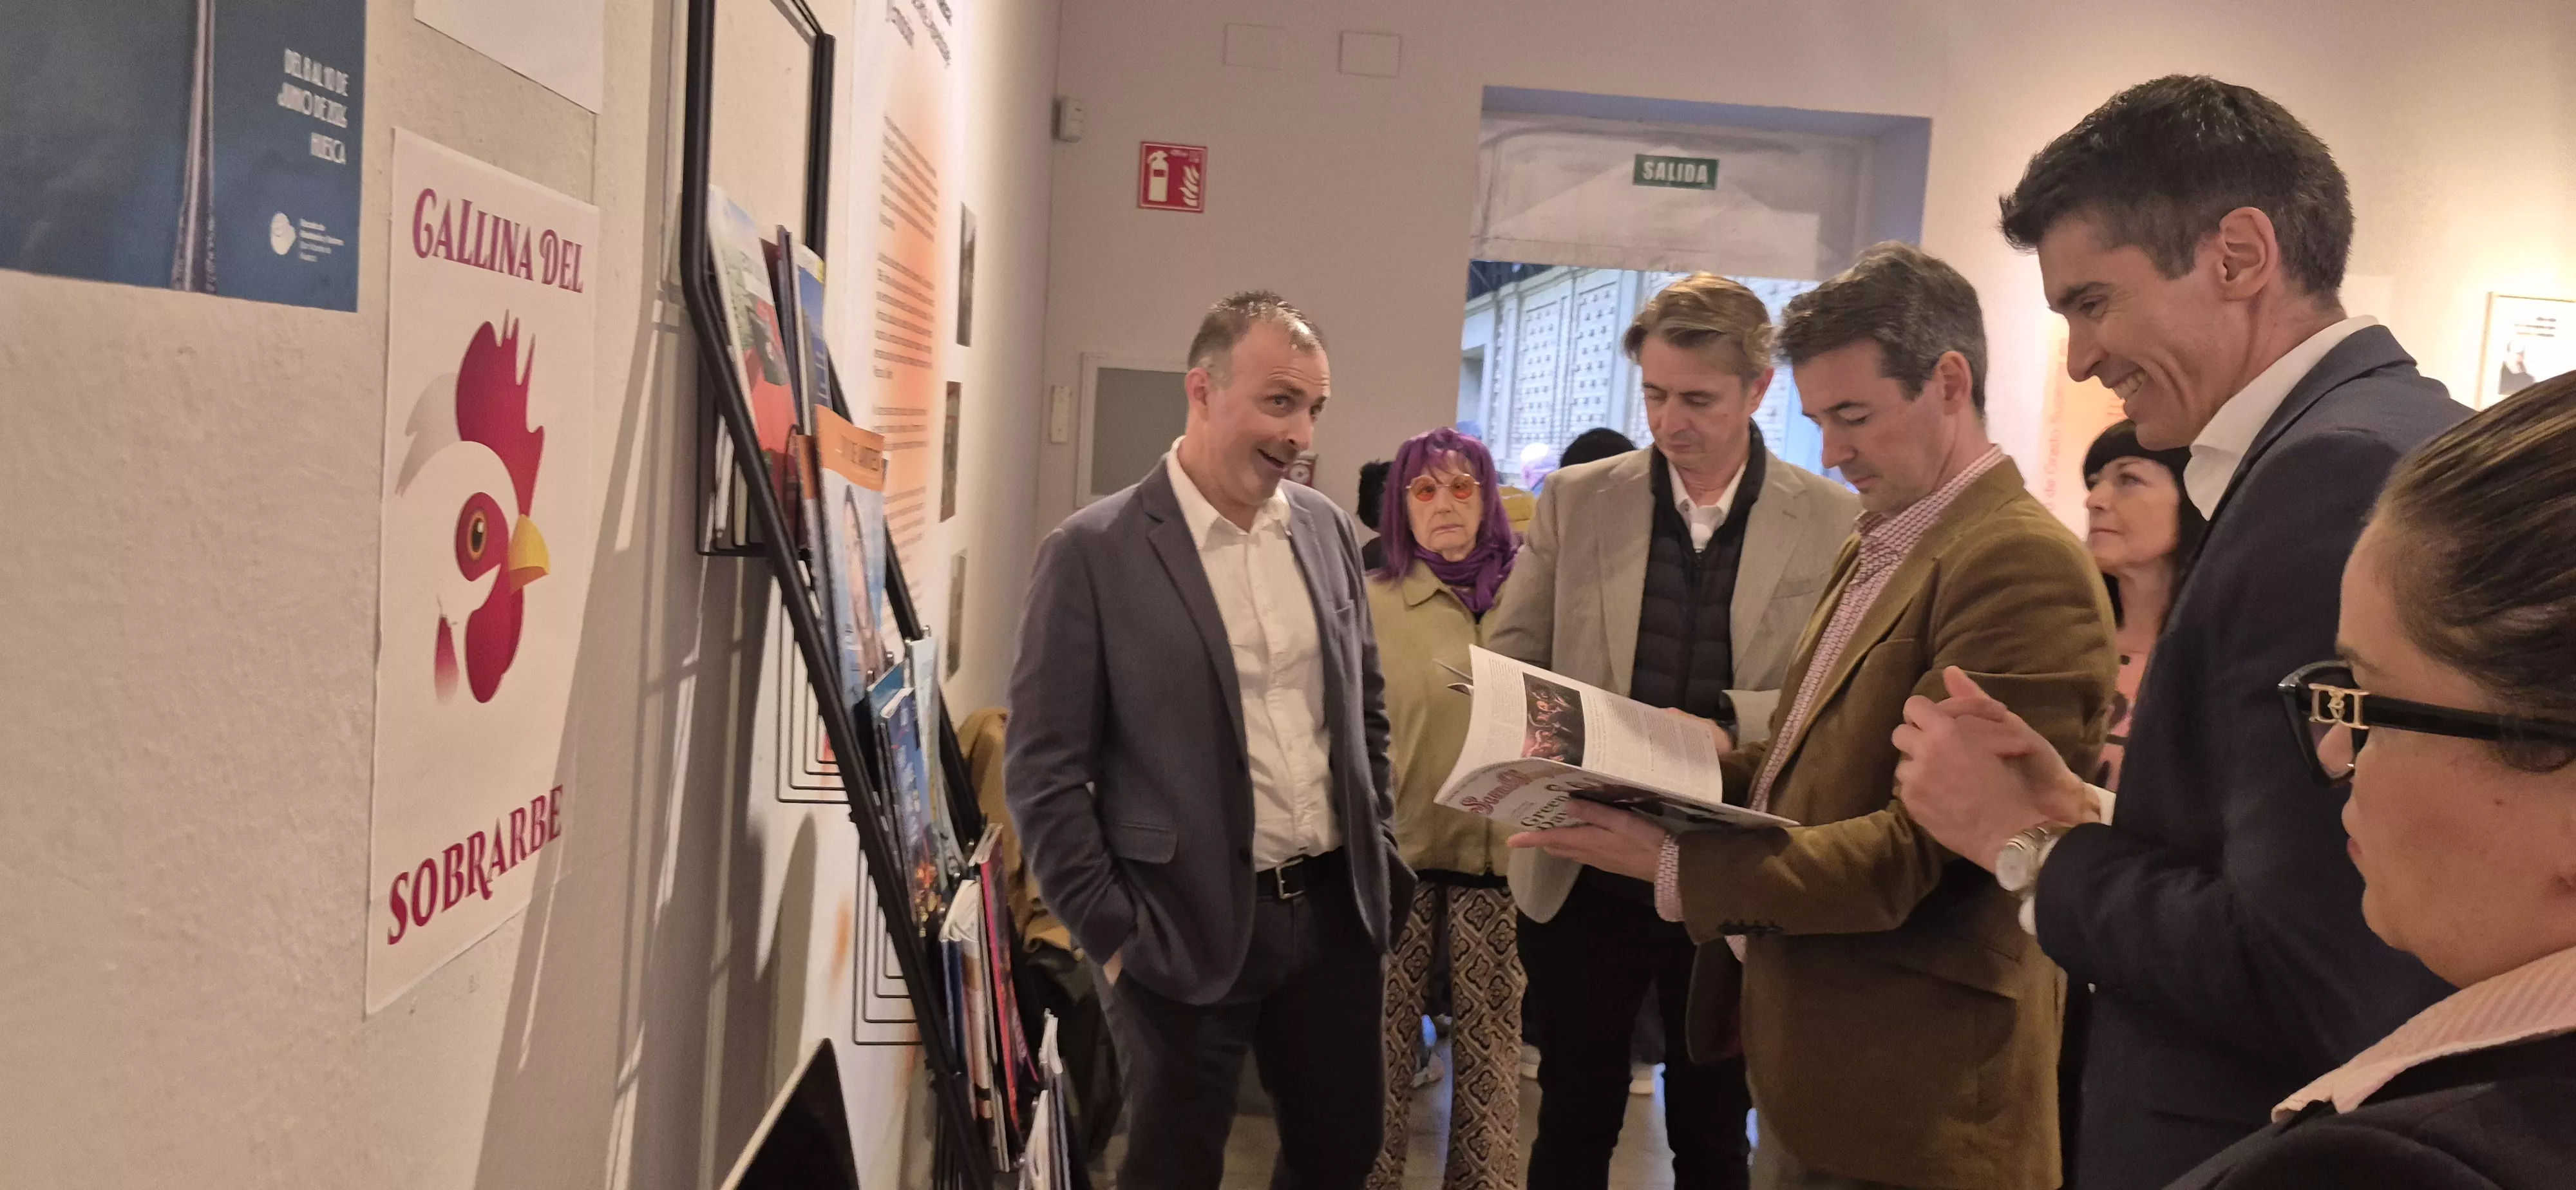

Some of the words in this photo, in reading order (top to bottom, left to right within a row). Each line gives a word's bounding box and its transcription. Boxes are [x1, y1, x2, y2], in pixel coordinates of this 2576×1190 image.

[1643, 162, 1708, 184] SALIDA
[412, 187, 534, 281] GALLINA
[539, 229, 583, 293] DEL
[387, 784, 564, 945] SOBRARBE
